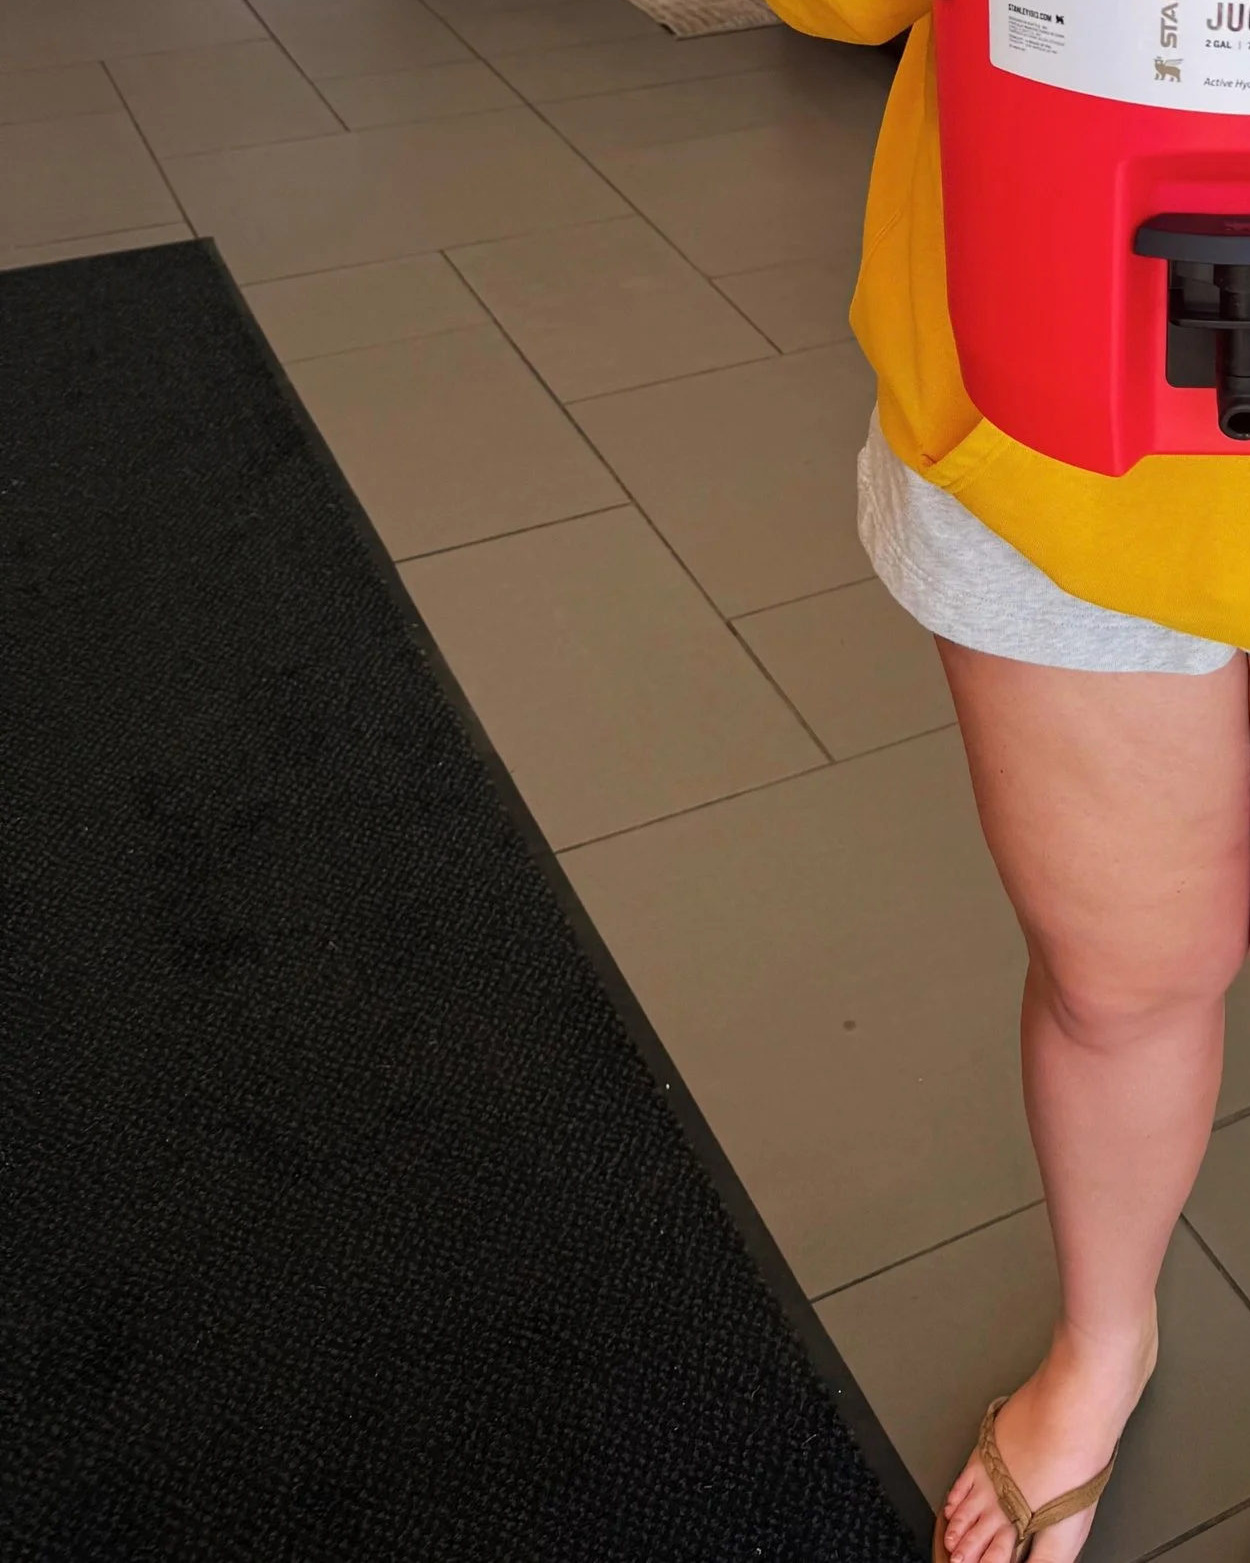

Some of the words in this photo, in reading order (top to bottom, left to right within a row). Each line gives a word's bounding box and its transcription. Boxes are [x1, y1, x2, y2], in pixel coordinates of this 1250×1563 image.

[1205, 39, 1211, 48] 2
[1213, 40, 1232, 50] GAL
[1203, 77, 1234, 88] Active
